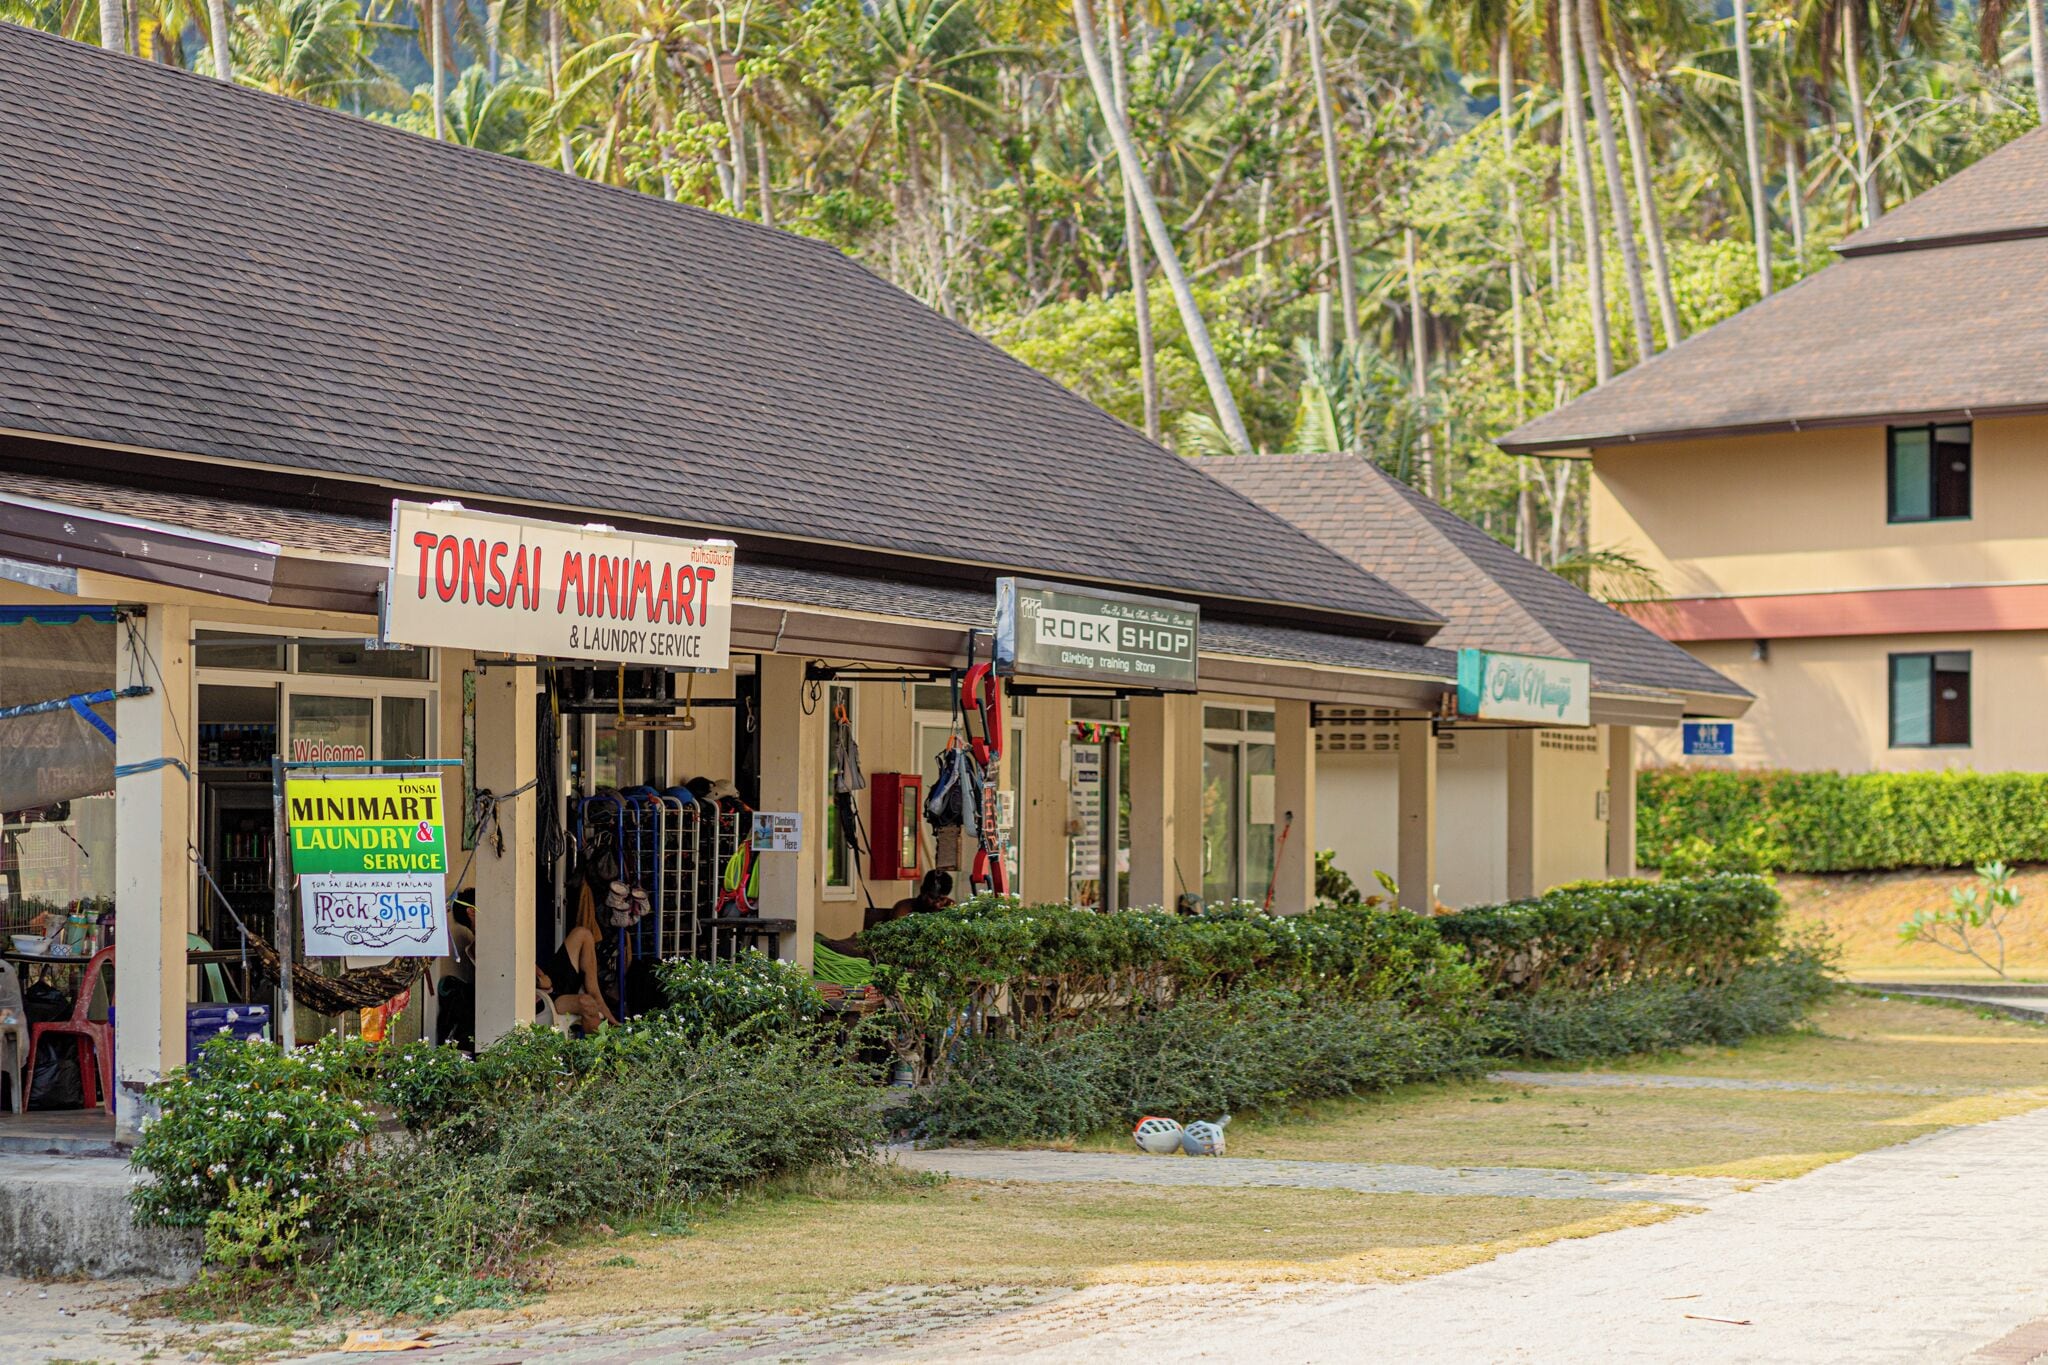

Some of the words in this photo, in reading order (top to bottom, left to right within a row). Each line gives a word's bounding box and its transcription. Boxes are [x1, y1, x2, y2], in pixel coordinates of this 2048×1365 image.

[413, 531, 542, 612] TONSAI
[557, 551, 715, 627] MINIMART
[569, 625, 580, 648] &
[584, 626, 646, 655] LAUNDRY
[650, 632, 701, 658] SERVICE
[1043, 617, 1112, 644] ROCK
[1122, 627, 1188, 653] SHOP
[1061, 651, 1094, 668] Climbing
[1100, 657, 1130, 673] training
[1135, 660, 1155, 673] Store
[294, 739, 365, 762] Welcome
[398, 784, 436, 794] TONSAI
[292, 797, 437, 821] MINIMART
[295, 828, 413, 850] LAUNDRY
[416, 821, 434, 842] &
[363, 853, 442, 870] SERVICE
[319, 895, 369, 922] Rock
[380, 893, 430, 929] Shop
